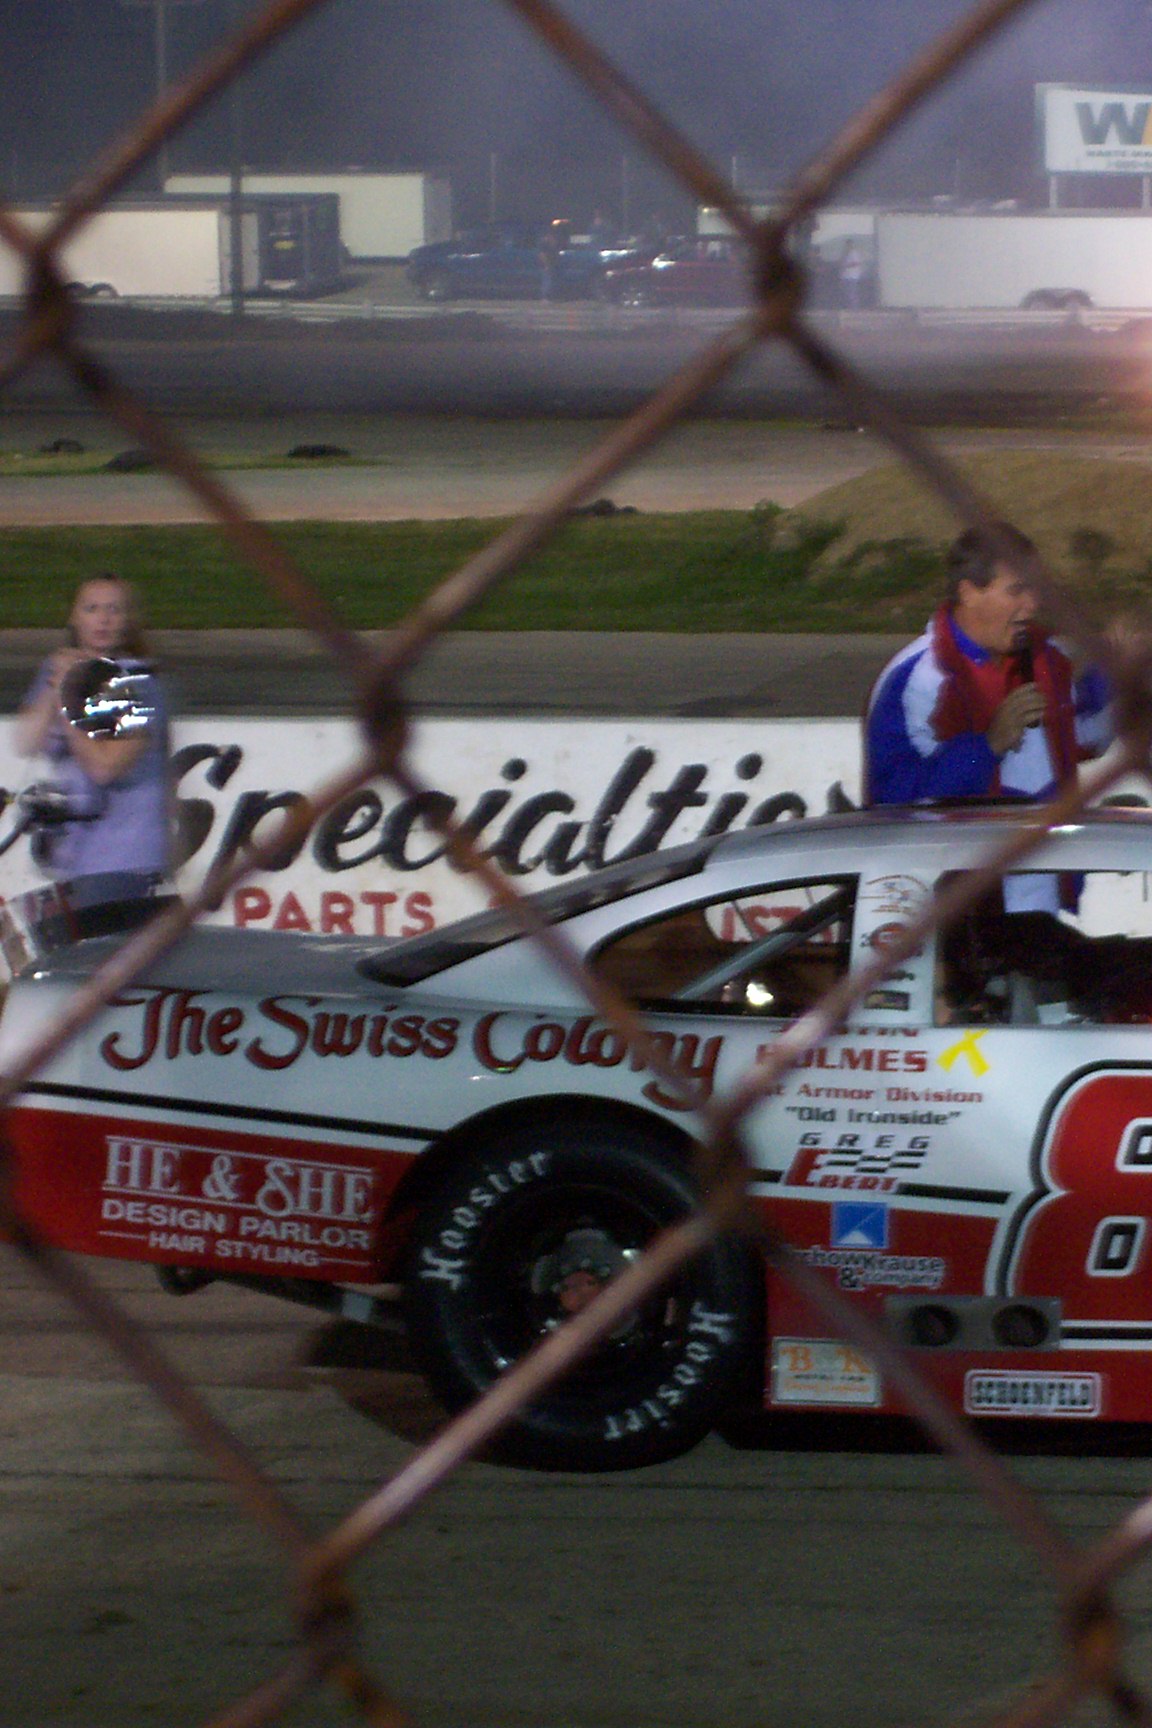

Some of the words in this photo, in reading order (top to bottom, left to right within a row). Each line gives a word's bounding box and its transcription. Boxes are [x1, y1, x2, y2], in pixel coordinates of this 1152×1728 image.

[232, 886, 437, 940] PARTS
[99, 983, 245, 1071] The
[245, 994, 461, 1071] Swiss
[473, 1010, 725, 1112] Colony
[885, 1086, 983, 1104] Division
[103, 1139, 182, 1194] HE
[201, 1154, 240, 1201] &
[255, 1158, 374, 1224] SHE
[102, 1198, 227, 1233] DESIGN
[239, 1215, 370, 1250] PARLOR
[148, 1230, 206, 1254] HAIR
[215, 1239, 321, 1267] STYLING
